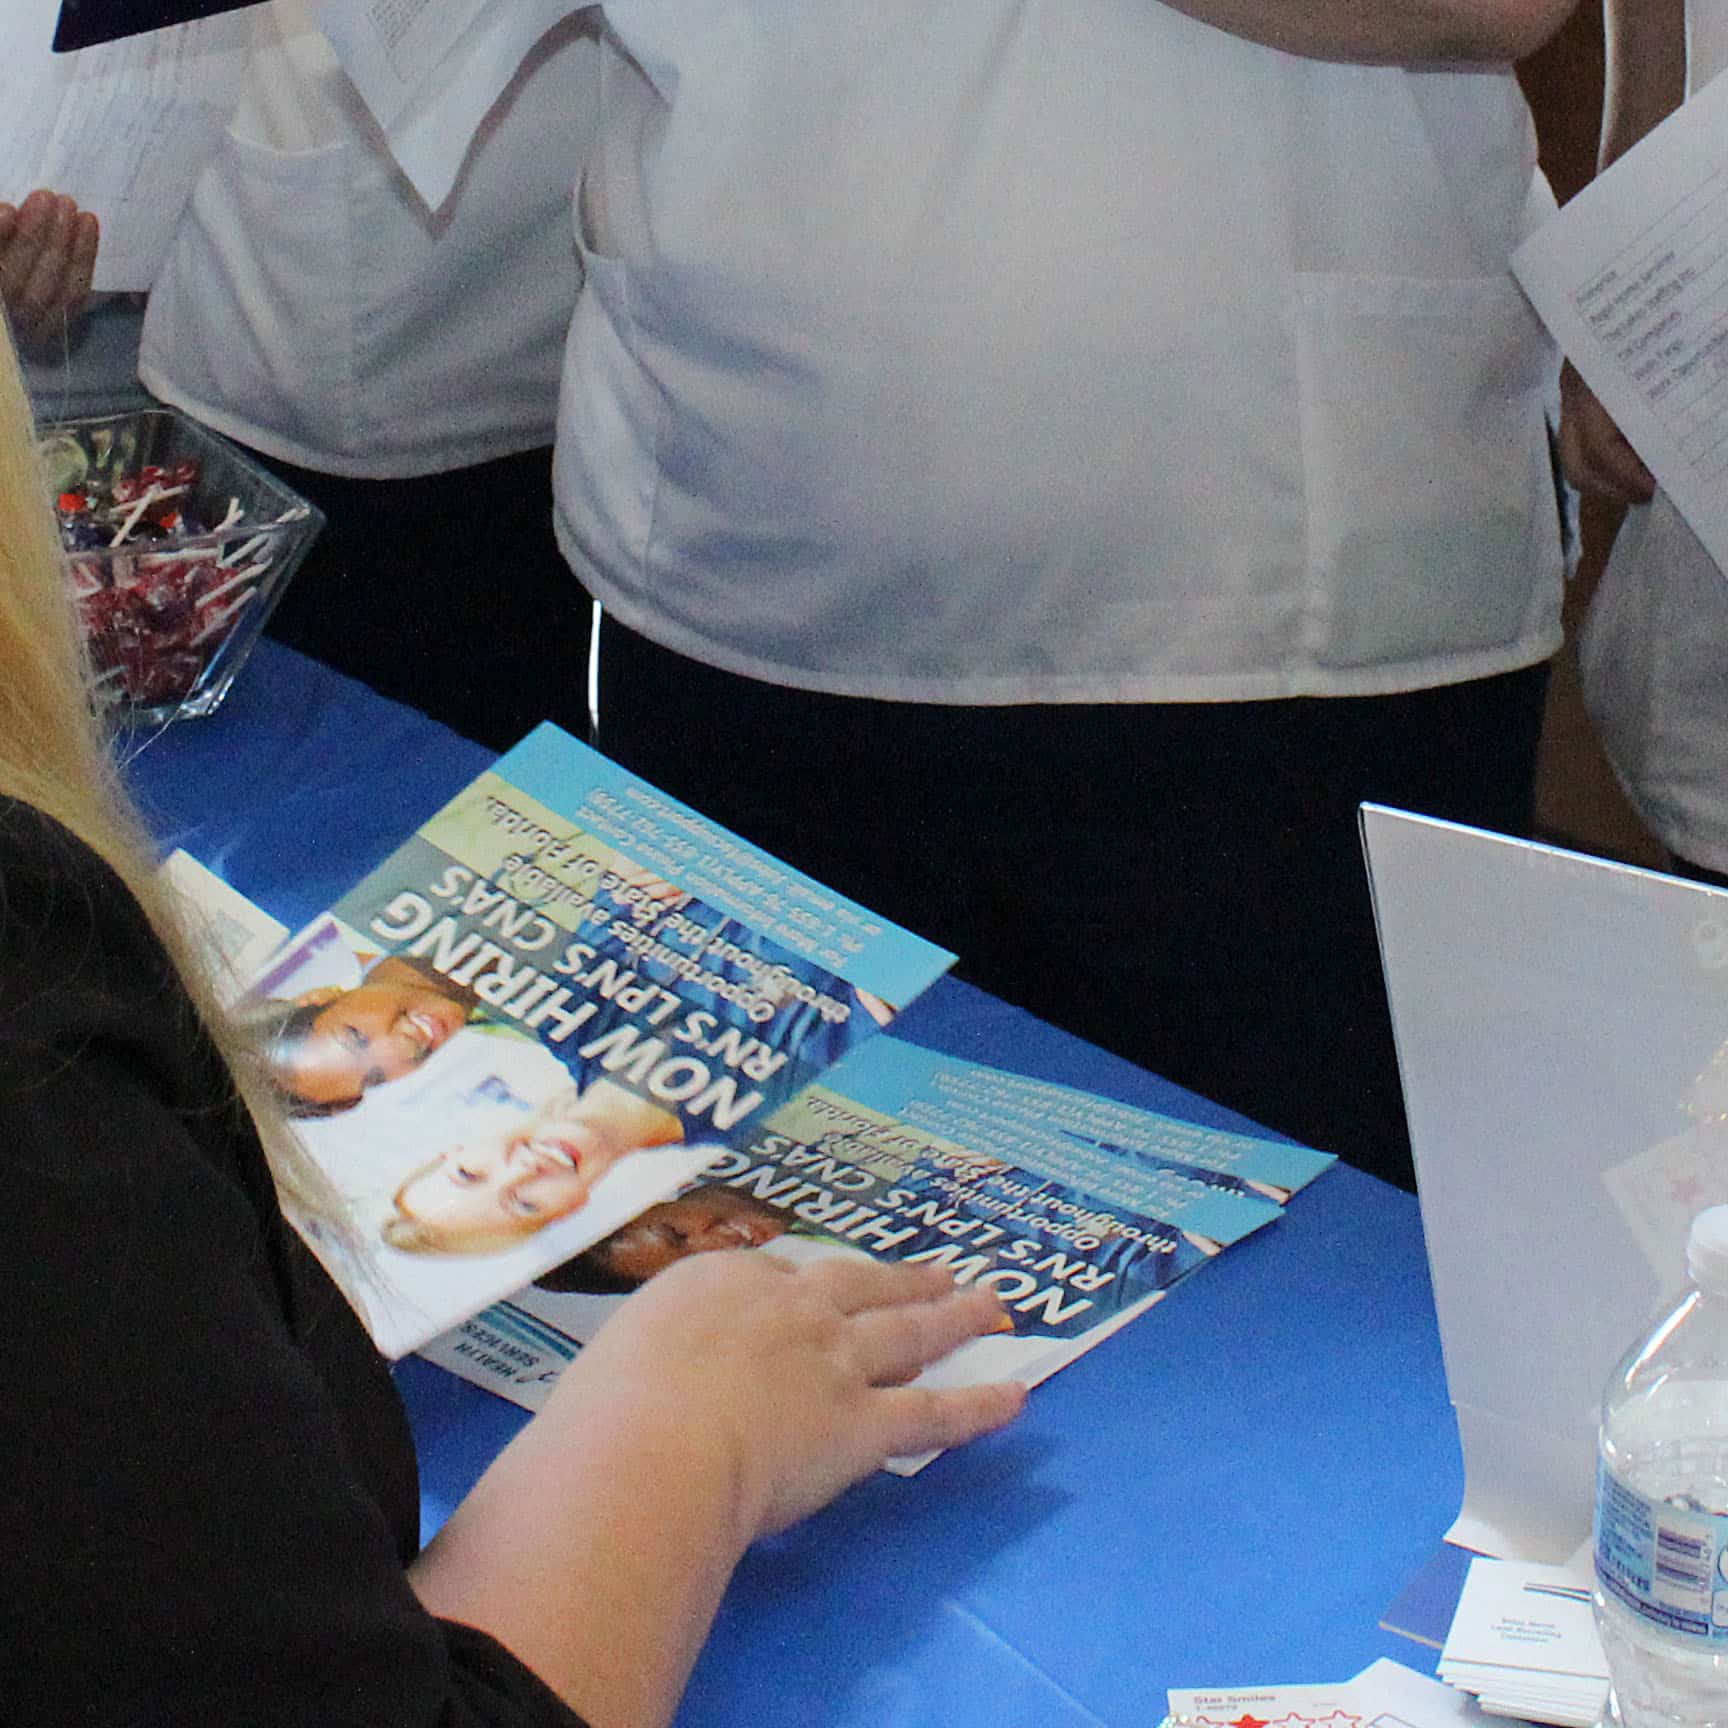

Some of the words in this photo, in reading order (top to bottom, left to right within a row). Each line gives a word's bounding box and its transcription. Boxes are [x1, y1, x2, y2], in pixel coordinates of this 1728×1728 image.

[498, 852, 612, 926] available
[558, 851, 601, 880] of
[592, 869, 667, 925] State
[426, 862, 561, 953] CNA'S
[661, 910, 712, 946] the
[367, 887, 599, 1042] HIRING
[553, 940, 684, 1024] LPN'S
[605, 918, 780, 1025] Opportunities
[702, 933, 853, 1024] throughout
[580, 1026, 765, 1131] NOW
[674, 1007, 790, 1081] RN'S
[747, 1131, 877, 1195] CNA'S
[984, 1172, 1031, 1198] the
[872, 1182, 1005, 1247] LPN'S
[926, 1176, 1102, 1252] Opportunities
[1022, 1188, 1178, 1255] throughout
[899, 1237, 1093, 1326] NOW
[995, 1233, 1116, 1295] RN'S
